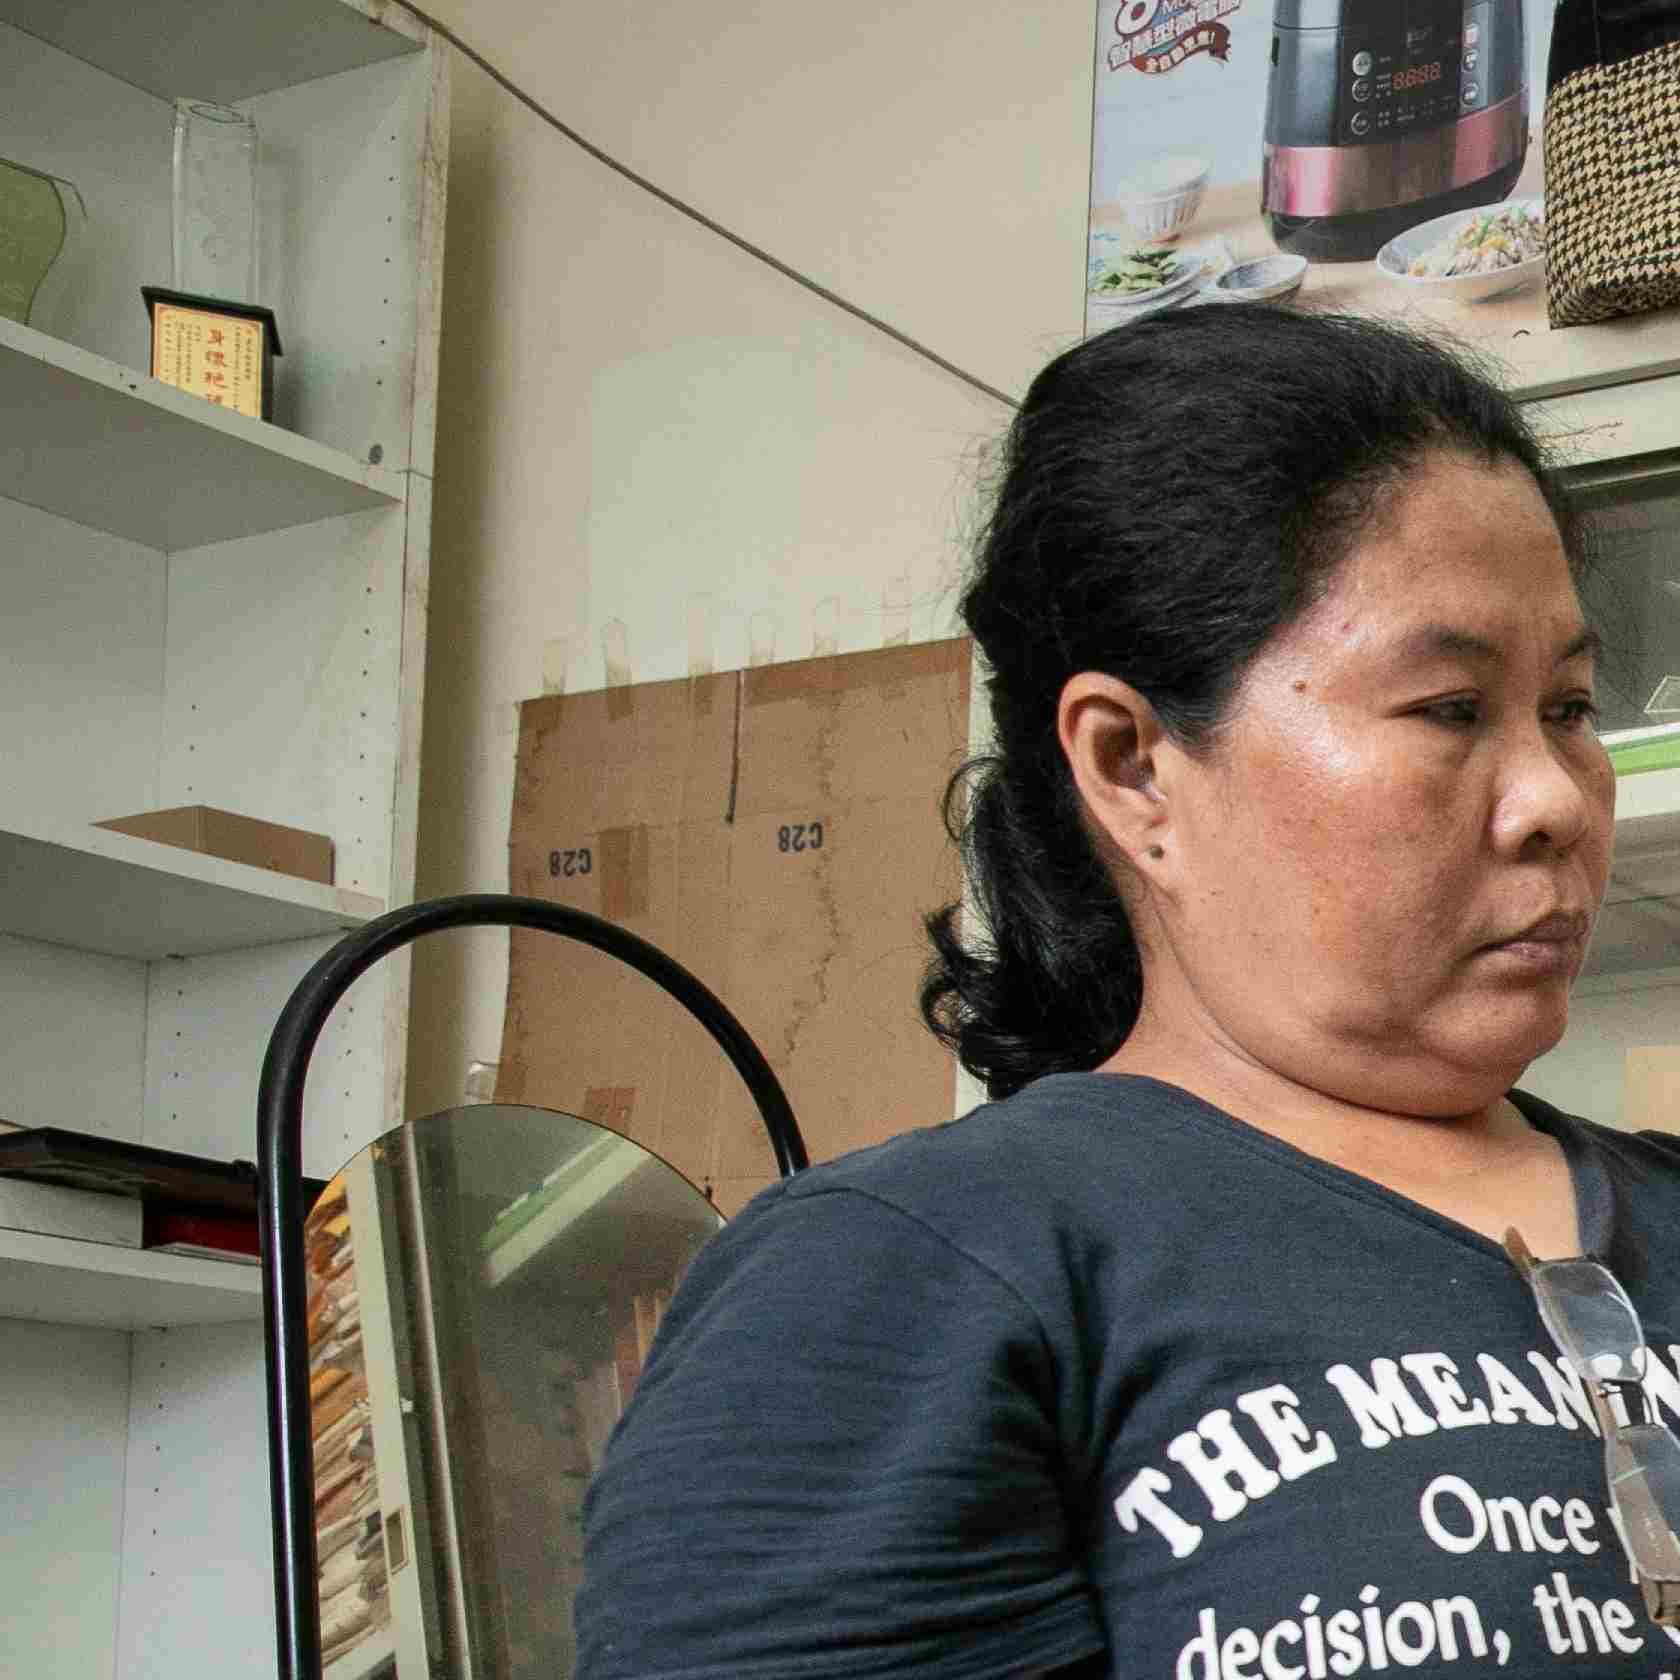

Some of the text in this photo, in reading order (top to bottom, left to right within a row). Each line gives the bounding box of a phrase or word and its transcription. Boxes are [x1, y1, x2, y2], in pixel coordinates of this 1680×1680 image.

[549, 848, 592, 878] C28
[778, 823, 824, 852] C28
[1115, 1384, 1338, 1560] THE
[1419, 1475, 1600, 1555] Once
[1533, 1572, 1644, 1656] the
